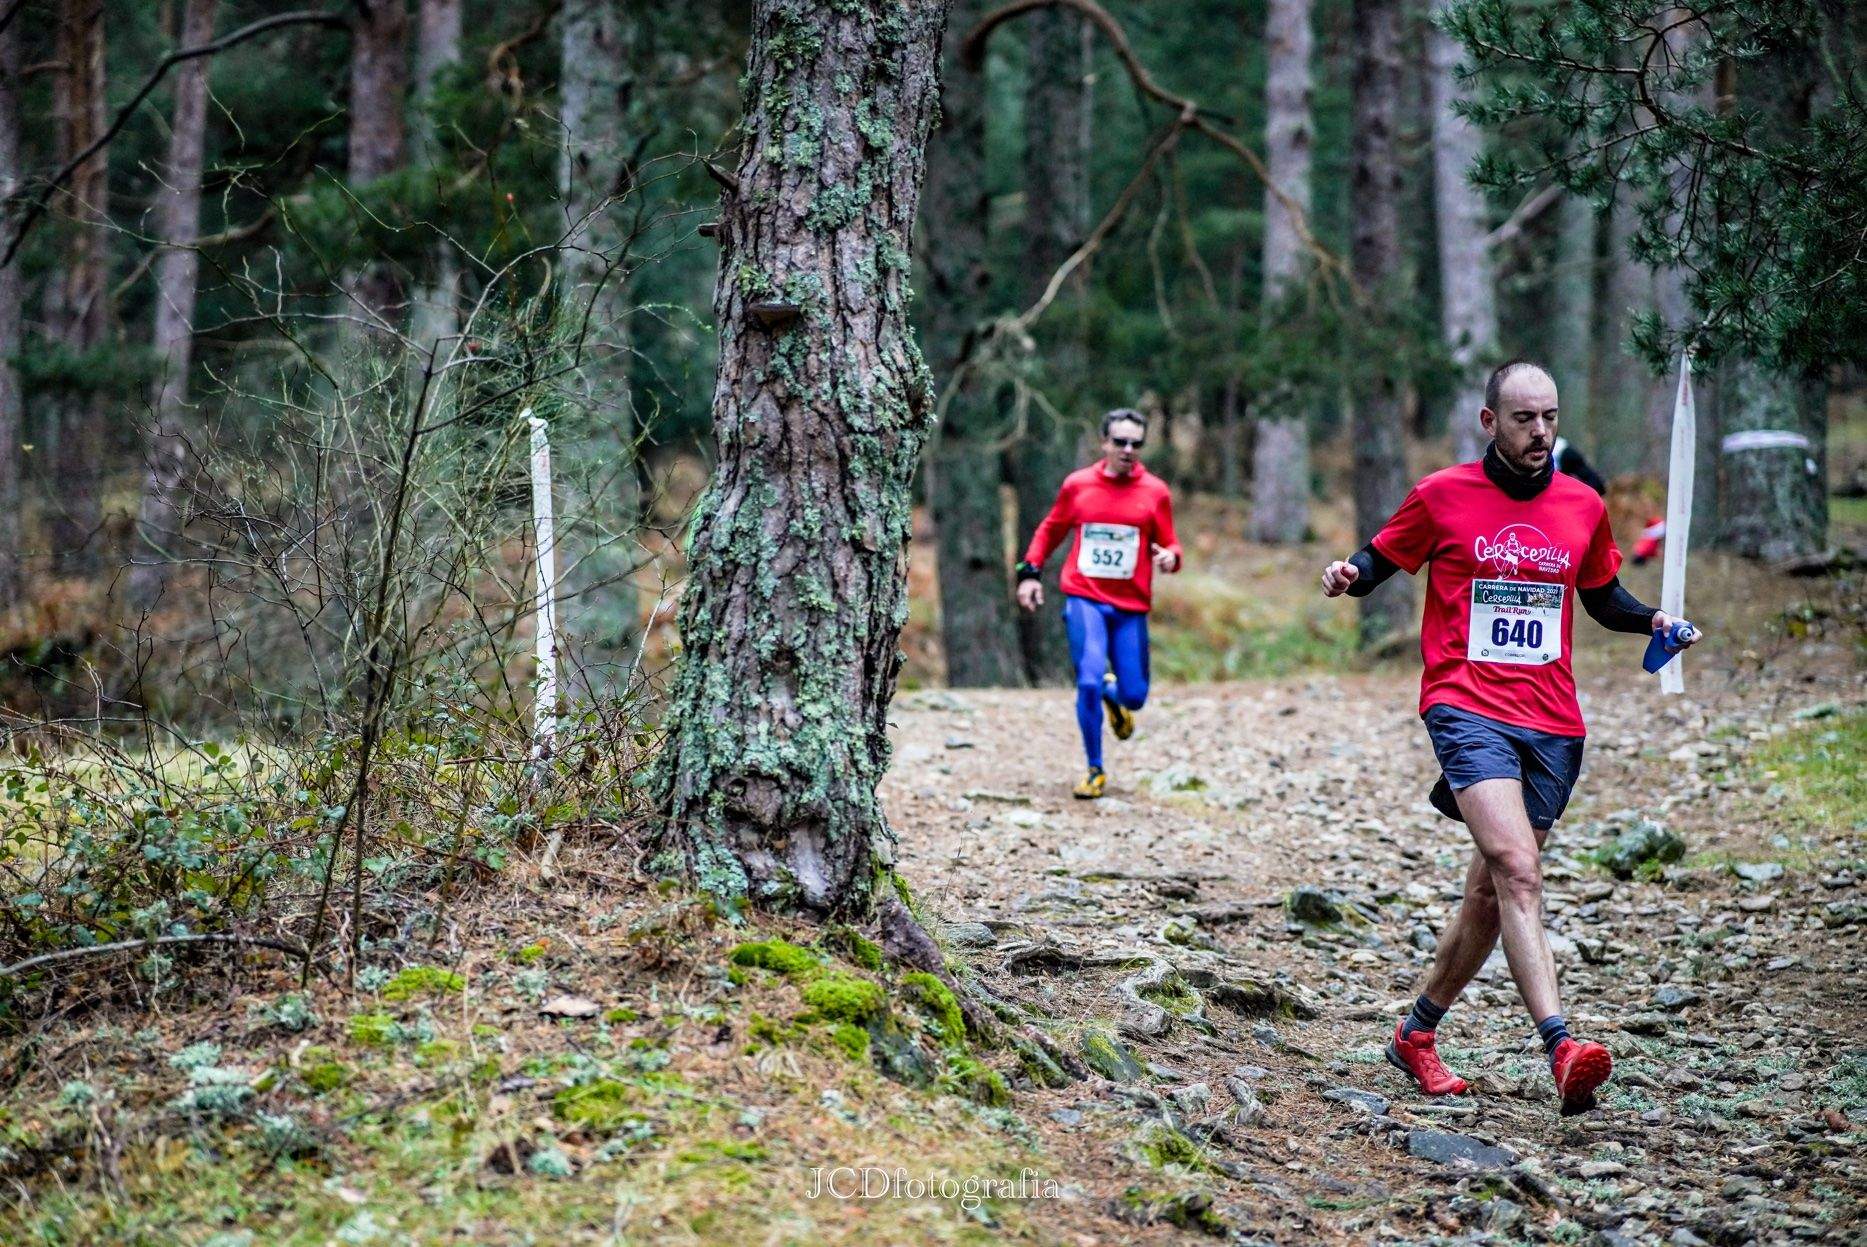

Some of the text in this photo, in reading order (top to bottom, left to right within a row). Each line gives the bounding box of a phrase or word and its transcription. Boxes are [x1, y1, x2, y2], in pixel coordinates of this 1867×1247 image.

[1092, 548, 1124, 566] 552
[1493, 605, 1512, 614] Trail
[1491, 617, 1543, 649] 640
